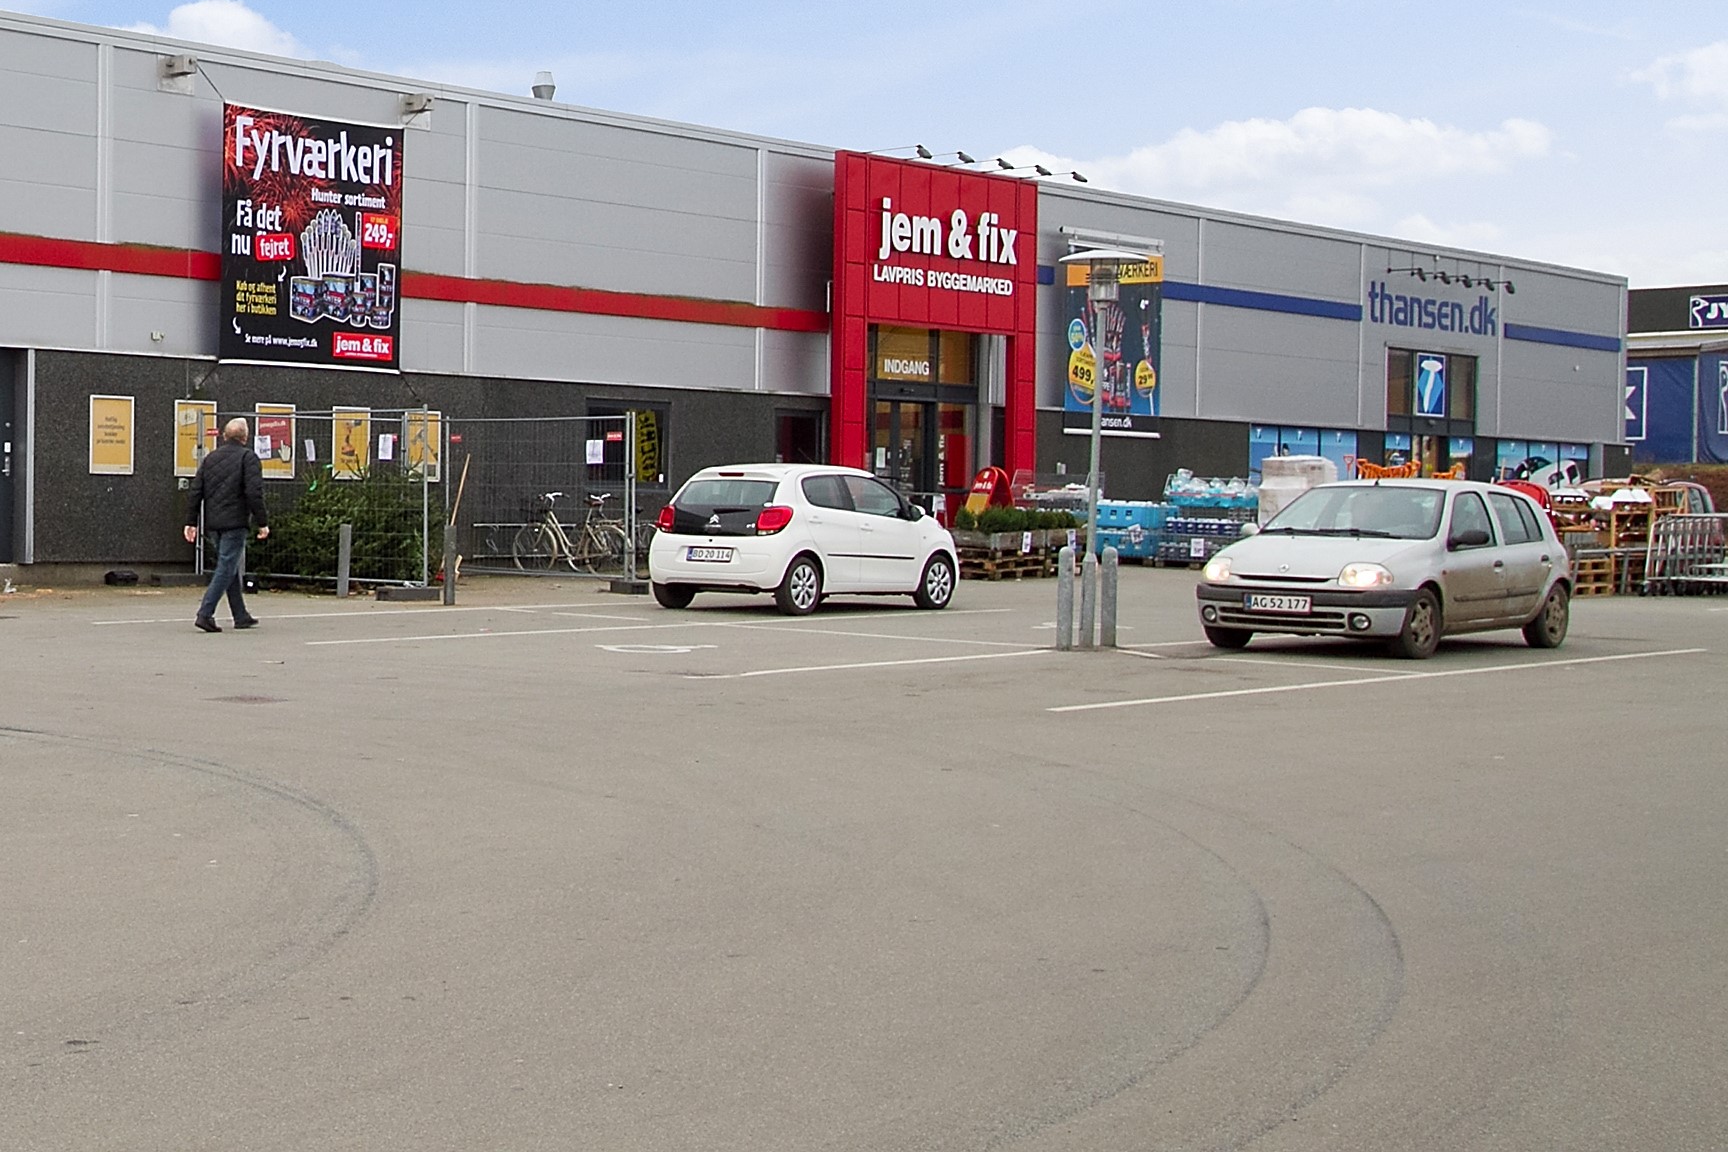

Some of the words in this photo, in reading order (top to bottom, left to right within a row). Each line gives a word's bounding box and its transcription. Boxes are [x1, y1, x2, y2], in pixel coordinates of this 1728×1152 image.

[236, 116, 393, 186] Fyrværkeri
[311, 188, 342, 204] Hunter
[344, 193, 386, 209] sortiment
[237, 199, 252, 228] Få
[256, 203, 282, 231] det
[878, 197, 942, 260] jem
[948, 209, 973, 259] &
[977, 212, 1017, 264] fix
[232, 233, 250, 255] nu
[260, 238, 290, 258] fejret
[873, 263, 924, 286] LAVPRIS
[927, 270, 1013, 296] BYGGEMARKED
[1368, 280, 1496, 336] thansen.dk
[336, 335, 362, 354] jem
[362, 338, 373, 351] &
[373, 338, 390, 354] fix
[884, 358, 930, 376] INDGANG
[1101, 416, 1132, 428] ansen.dk
[705, 550, 714, 558] 20
[716, 551, 730, 559] 114
[1252, 596, 1267, 608] AG
[1270, 598, 1283, 608] 52
[1287, 599, 1308, 609] 177
